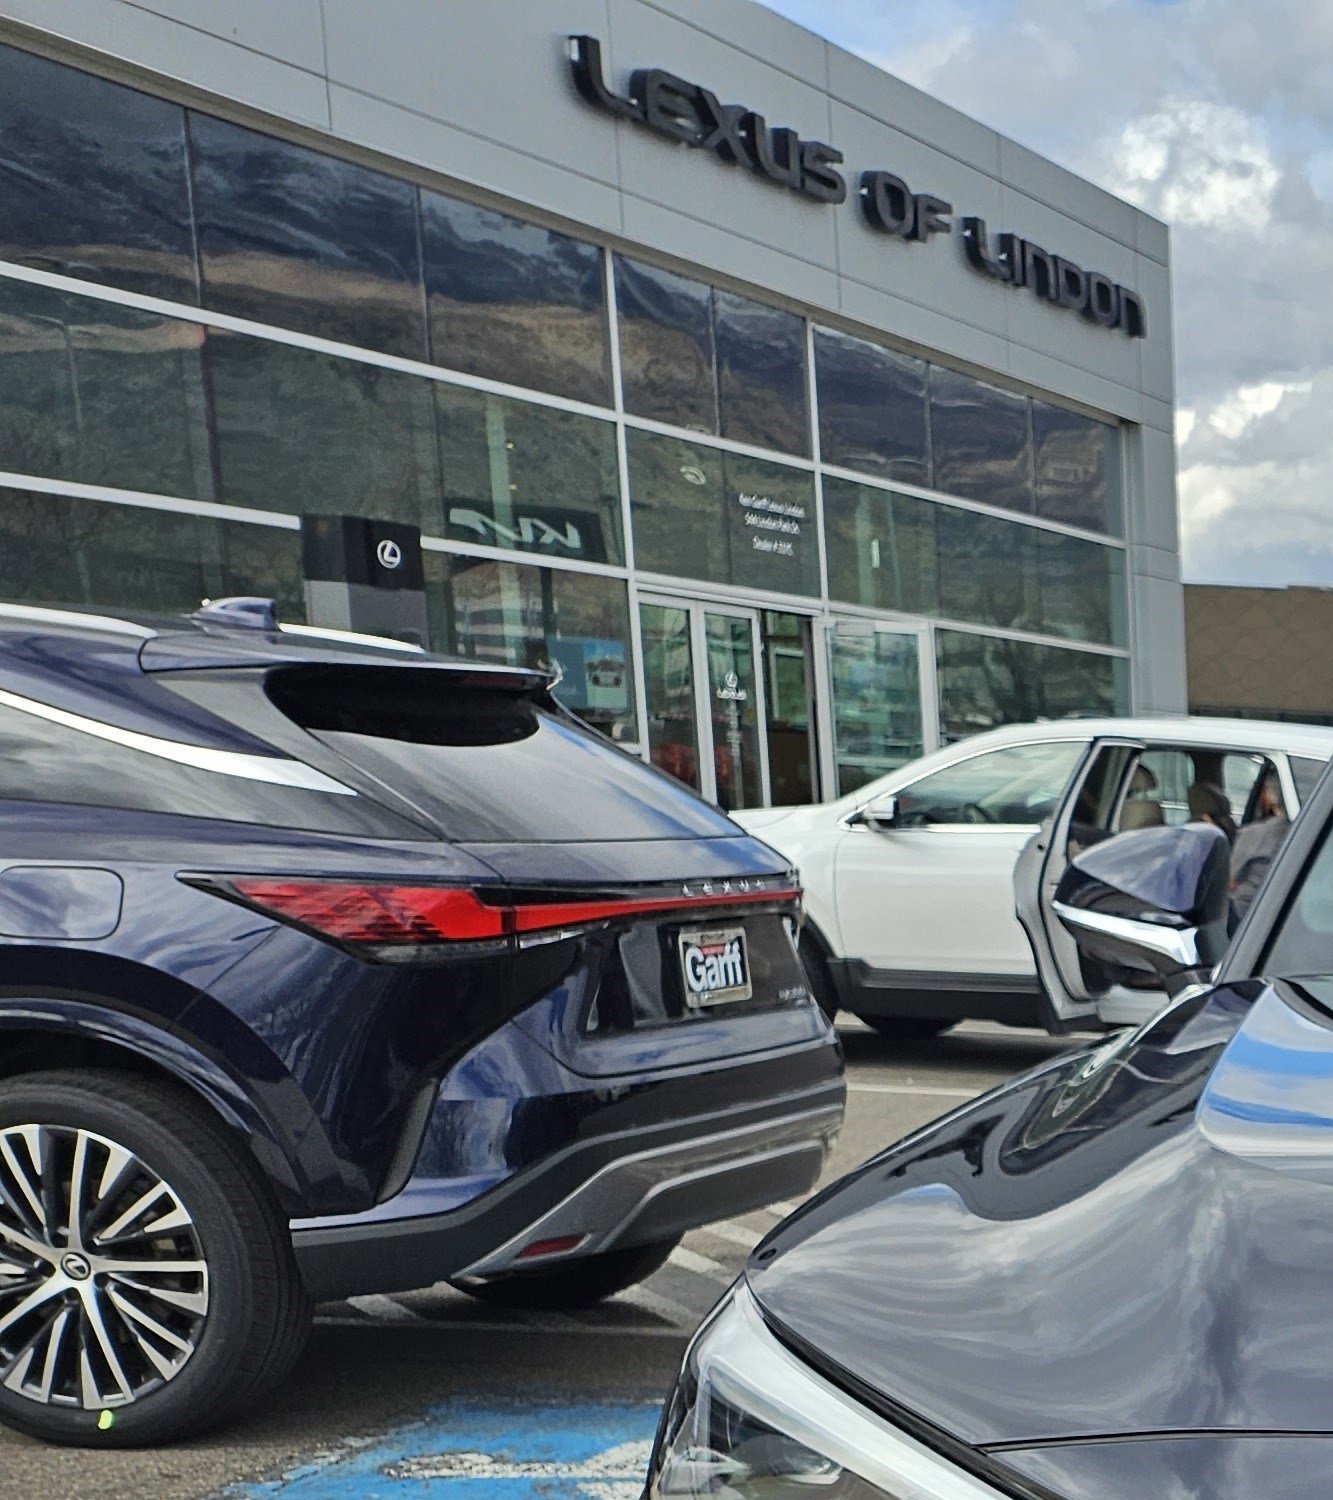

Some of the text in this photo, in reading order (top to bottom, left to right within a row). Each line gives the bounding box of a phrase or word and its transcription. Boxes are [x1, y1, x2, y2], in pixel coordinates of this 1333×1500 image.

[567, 35, 1147, 338] LEXUS OF LINDON
